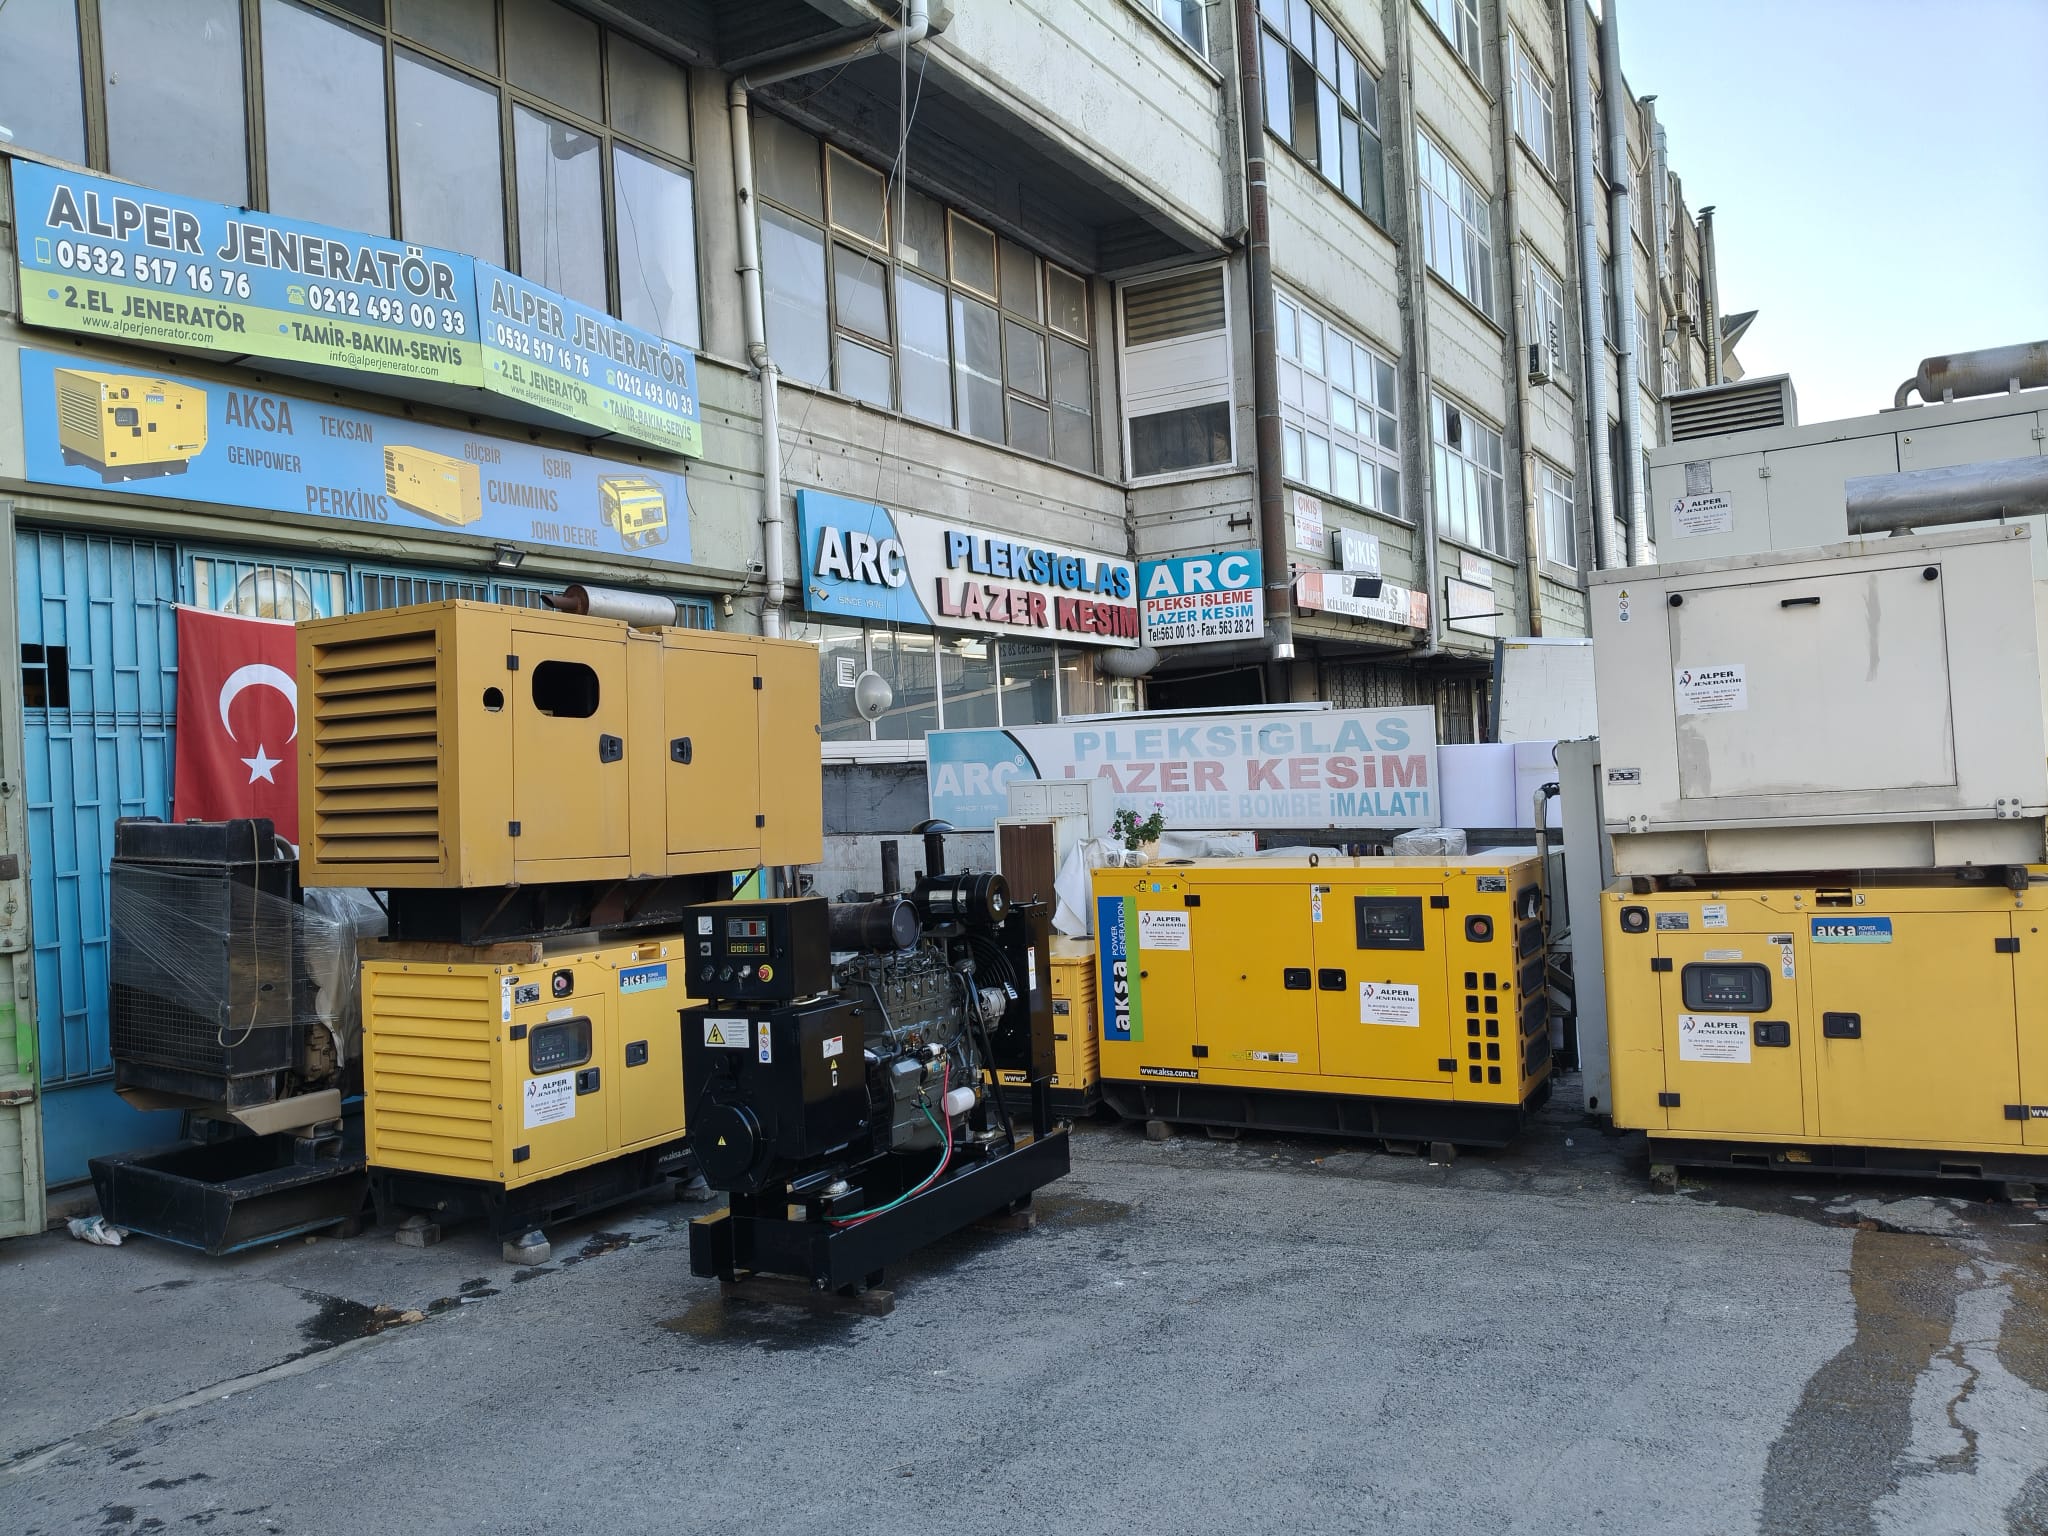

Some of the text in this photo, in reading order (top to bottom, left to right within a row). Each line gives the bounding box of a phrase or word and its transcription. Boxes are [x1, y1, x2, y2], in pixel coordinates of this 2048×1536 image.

[46, 184, 457, 304] ALPER JENERATÖR
[56, 239, 252, 300] 0532 517 16 76
[64, 285, 247, 334] 2.EL JENERATÖR
[307, 284, 466, 336] 0212 493 00 33
[82, 315, 214, 345] www.alperjenerator.com
[291, 321, 463, 367] TAMİR-BAKIM-SERVİS
[491, 279, 689, 390] ALPER JENERATÖR
[329, 350, 440, 377] info@alperjenerator.com
[497, 322, 590, 379] 0532 517 16 76
[501, 358, 589, 408] 2.EL JENERATÖR
[616, 368, 694, 417] 0212 493 00 33
[225, 391, 294, 436] AKSA
[319, 415, 374, 444] TEKSAN
[609, 399, 692, 442] TAMİR-BAKIM-SERVİS
[227, 445, 301, 474] GENPOWER
[542, 453, 572, 481] İŞBİR
[305, 485, 389, 522] PERKİNS
[487, 479, 558, 514] CUMMINS
[1691, 498, 1721, 506] ALPER
[531, 519, 599, 549] JOHN DEERE
[815, 526, 907, 589] ARC
[1345, 537, 1378, 570] ÇIKIŞ
[1145, 555, 1250, 598] ARC
[936, 577, 1049, 629] LAZER
[1147, 610, 1197, 626] LAZER
[1327, 598, 1359, 614] KİLİMCİ
[1361, 605, 1386, 619] SANAYİ
[1175, 625, 1185, 638] 00
[1187, 623, 1195, 637] 13
[1201, 622, 1217, 636] Fax:
[1218, 620, 1232, 634] 563
[1234, 619, 1244, 633] 28
[1245, 618, 1254, 632] 21
[1700, 671, 1734, 680] ALPER
[1239, 792, 1322, 818] BOMBE
[1111, 926, 1119, 956] POWER
[1817, 926, 1856, 936] aksa
[623, 974, 648, 987] aksa
[1113, 961, 1131, 1031] aksa
[542, 1079, 567, 1090] ALPER
[1141, 1068, 1197, 1078] www.aksa.com.tr
